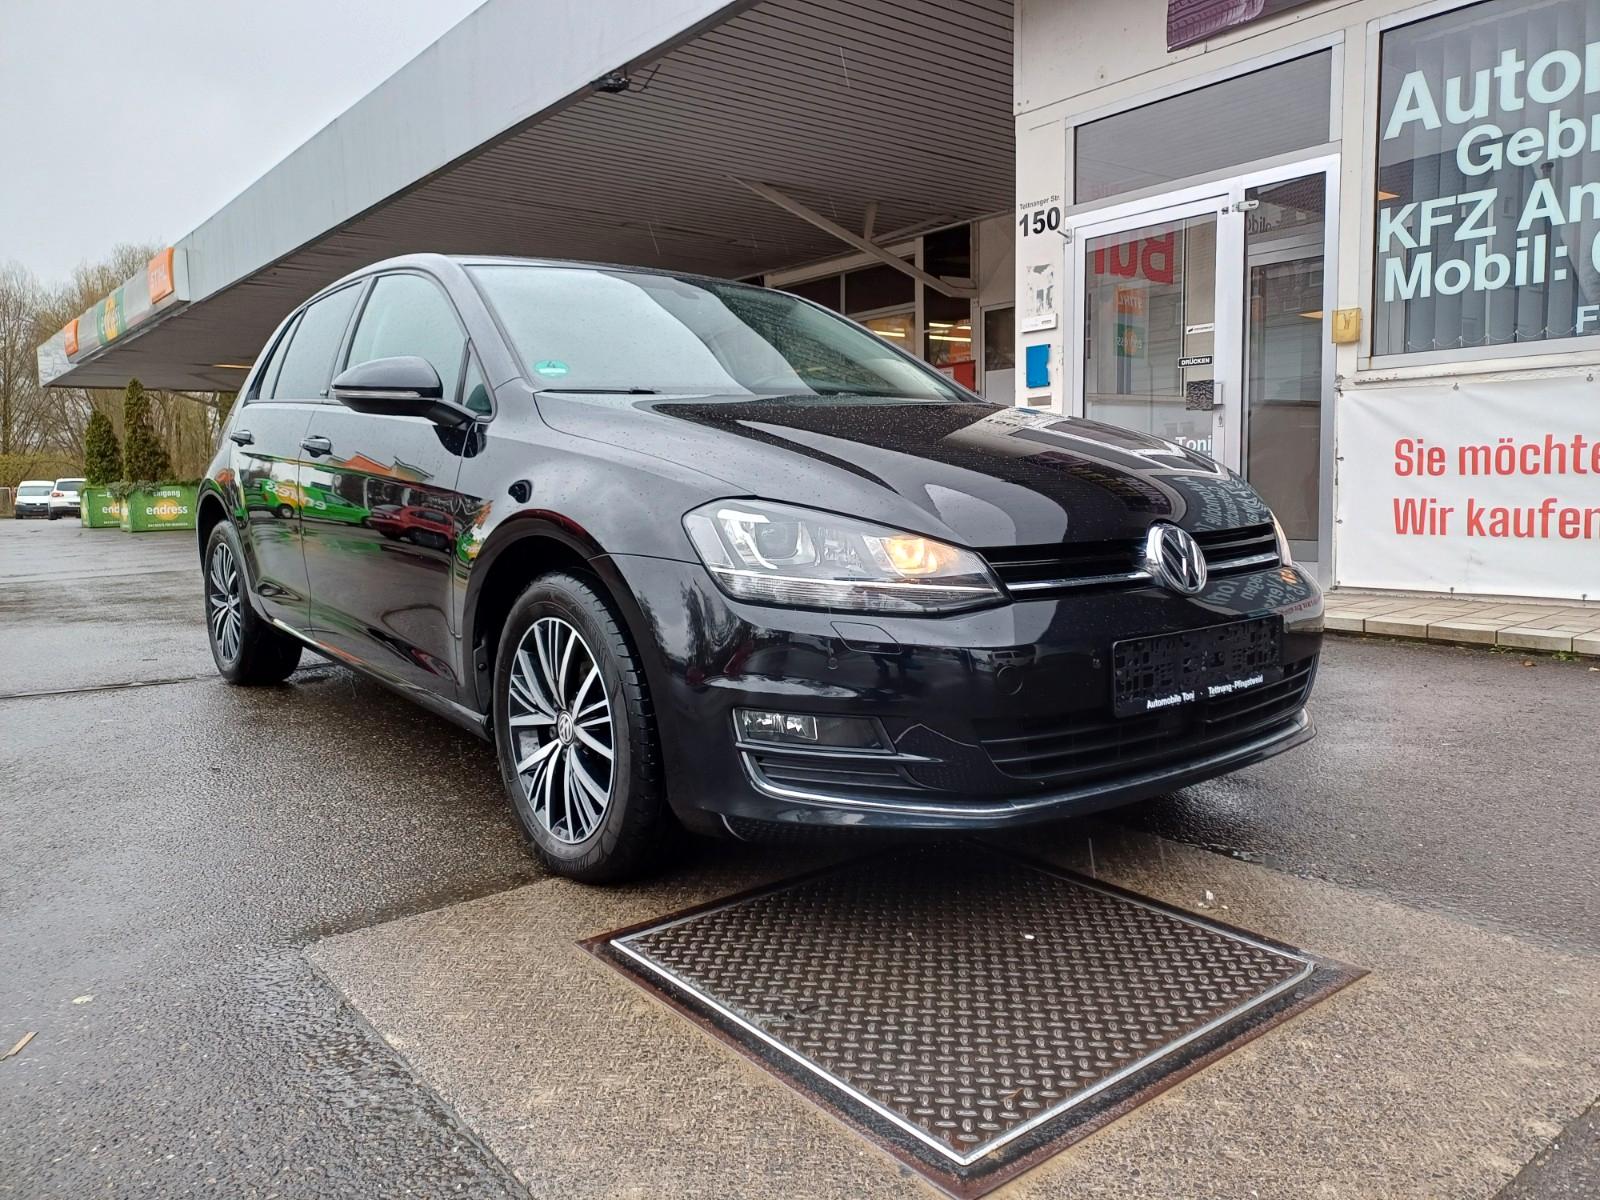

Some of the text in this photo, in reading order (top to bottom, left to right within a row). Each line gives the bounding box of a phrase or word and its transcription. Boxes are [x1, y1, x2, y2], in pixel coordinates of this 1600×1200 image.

[1383, 41, 1600, 140] Auto
[1019, 206, 1061, 237] 150
[1378, 187, 1498, 253] KFZ
[1384, 234, 1568, 303] Mobil:
[1175, 434, 1212, 451] Toni
[1394, 437, 1446, 477] Sie
[145, 504, 189, 515] endress
[1393, 497, 1454, 536] Wir
[1147, 693, 1182, 709] Automobile
[1182, 690, 1195, 702] Toni
